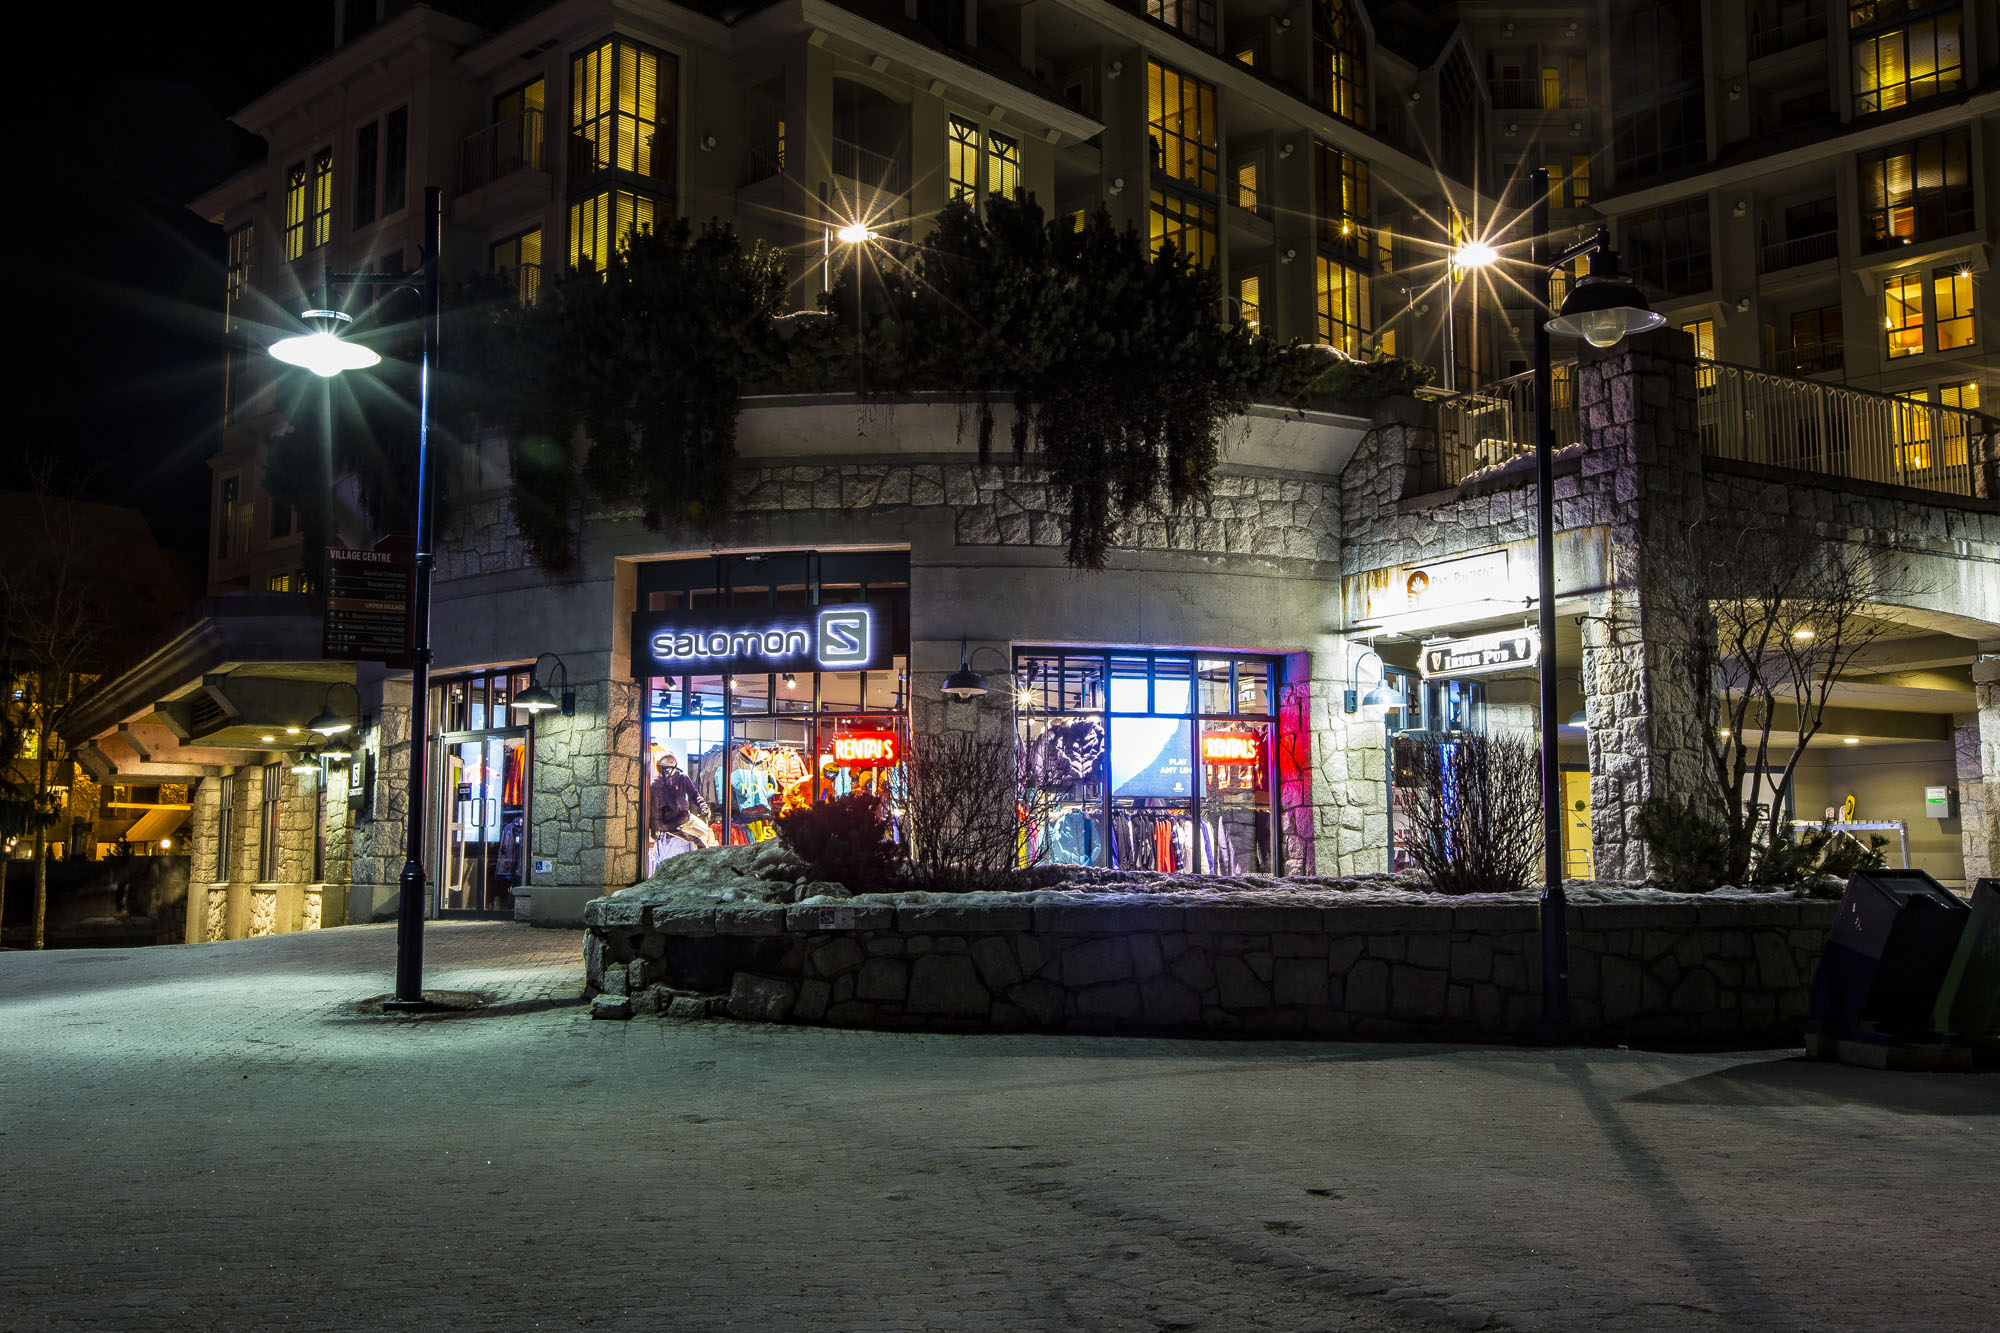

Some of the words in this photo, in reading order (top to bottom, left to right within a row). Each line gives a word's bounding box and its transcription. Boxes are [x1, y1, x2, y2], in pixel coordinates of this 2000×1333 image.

[330, 549, 361, 560] VILLAGE
[362, 552, 391, 563] CENTRE
[652, 630, 806, 657] salomon
[836, 738, 893, 759] RENTALS
[1206, 738, 1256, 758] RENTALS
[1169, 758, 1187, 766] PLAY
[1160, 766, 1178, 774] ANY
[1180, 766, 1192, 774] LIN
[741, 783, 759, 795] TO
